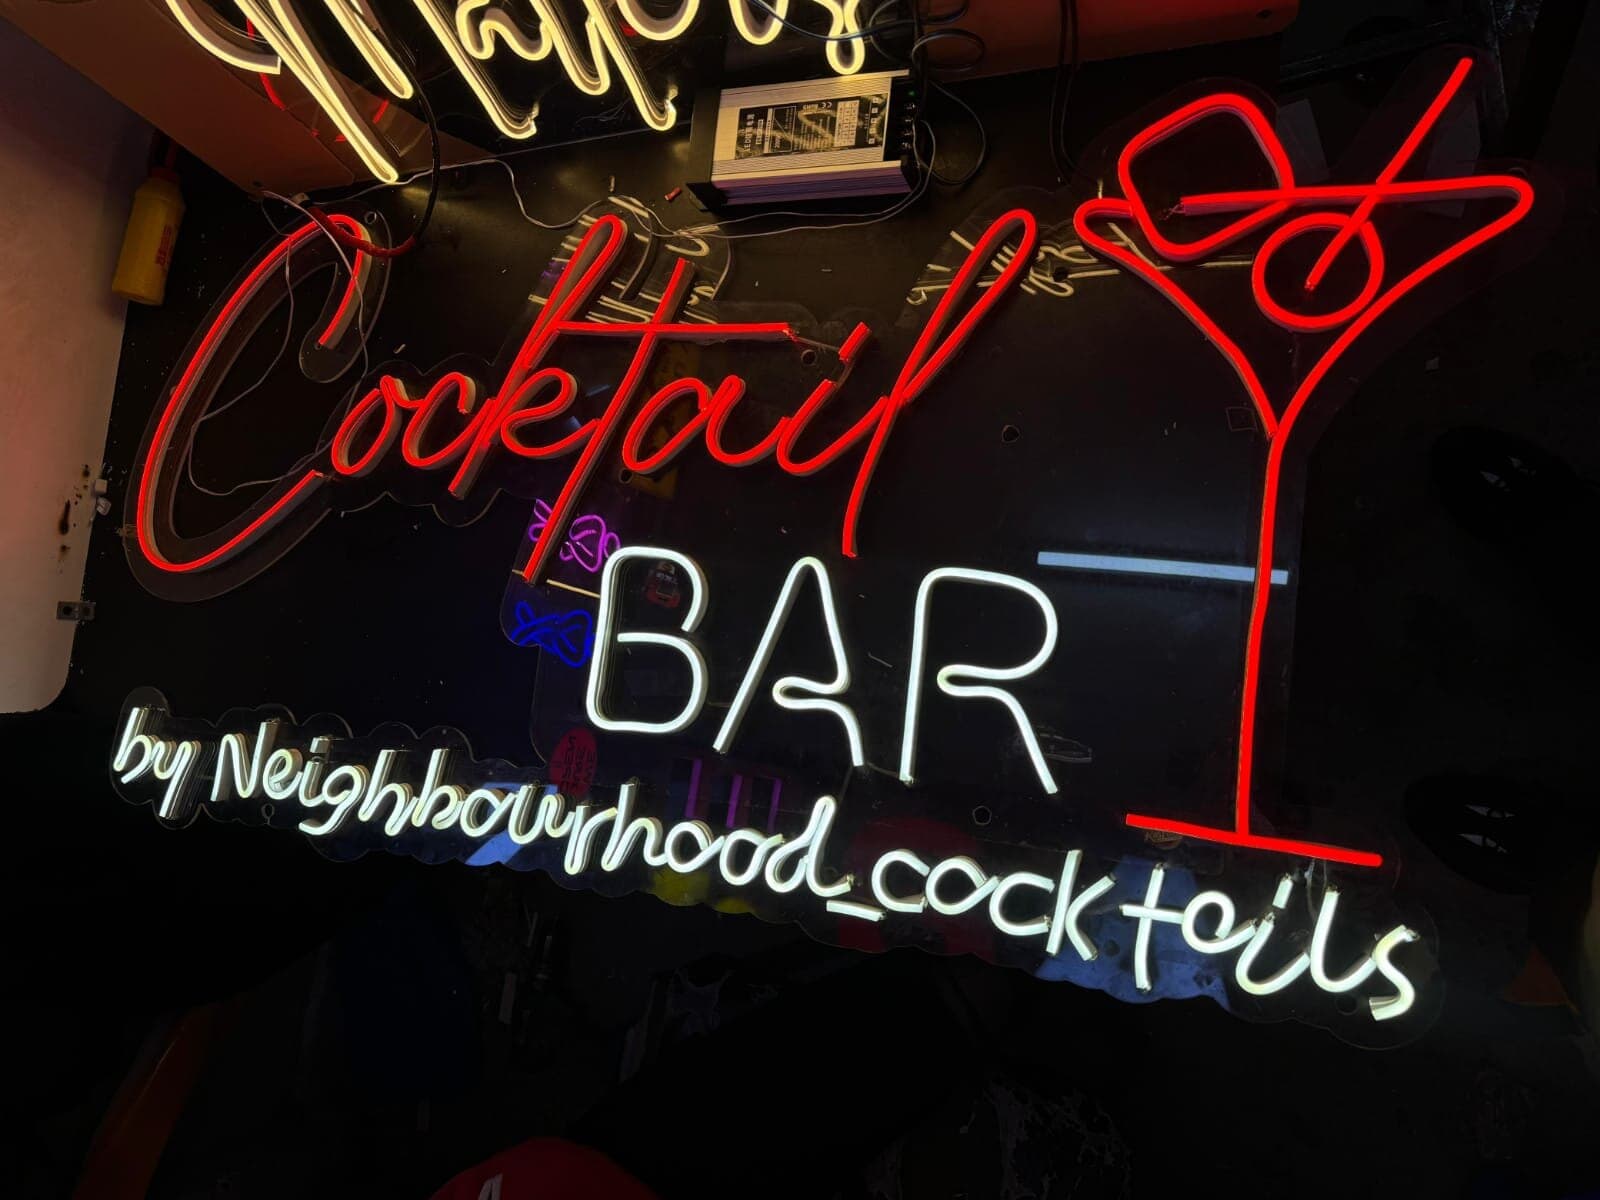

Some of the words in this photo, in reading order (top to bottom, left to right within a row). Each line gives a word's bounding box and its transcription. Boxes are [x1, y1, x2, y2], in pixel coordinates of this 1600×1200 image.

[136, 209, 1037, 583] Cocktail
[112, 706, 199, 819] by
[585, 545, 1059, 795] BAR
